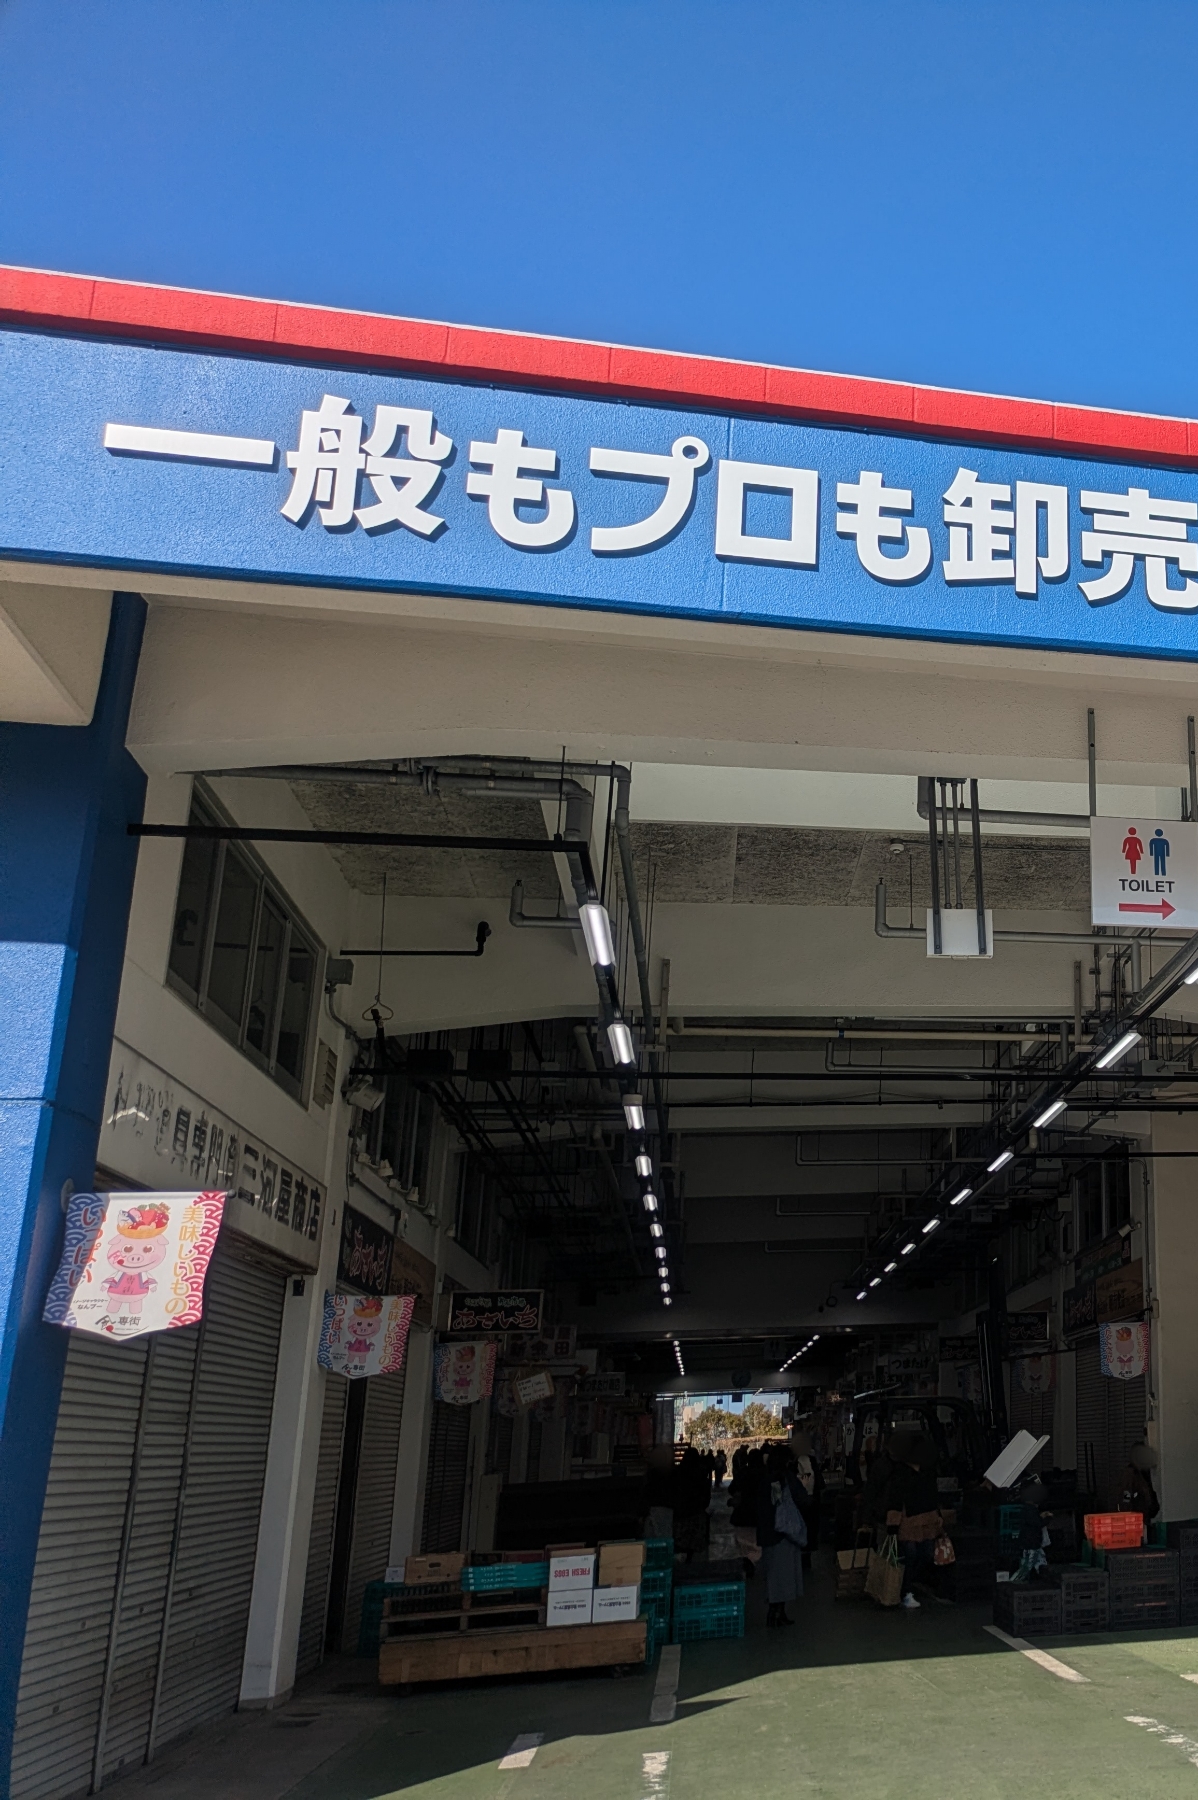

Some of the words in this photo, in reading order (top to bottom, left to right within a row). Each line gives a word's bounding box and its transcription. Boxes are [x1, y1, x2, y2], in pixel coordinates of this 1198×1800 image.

[1118, 878, 1175, 893] TOILET
[69, 1207, 106, 1288] いっぱい
[165, 1205, 204, 1315] 美味しいもの
[327, 1294, 348, 1345] いっぱい
[379, 1299, 402, 1365] 美味しいもの
[553, 1568, 570, 1578] EGGS
[571, 1567, 591, 1577] FRESH
